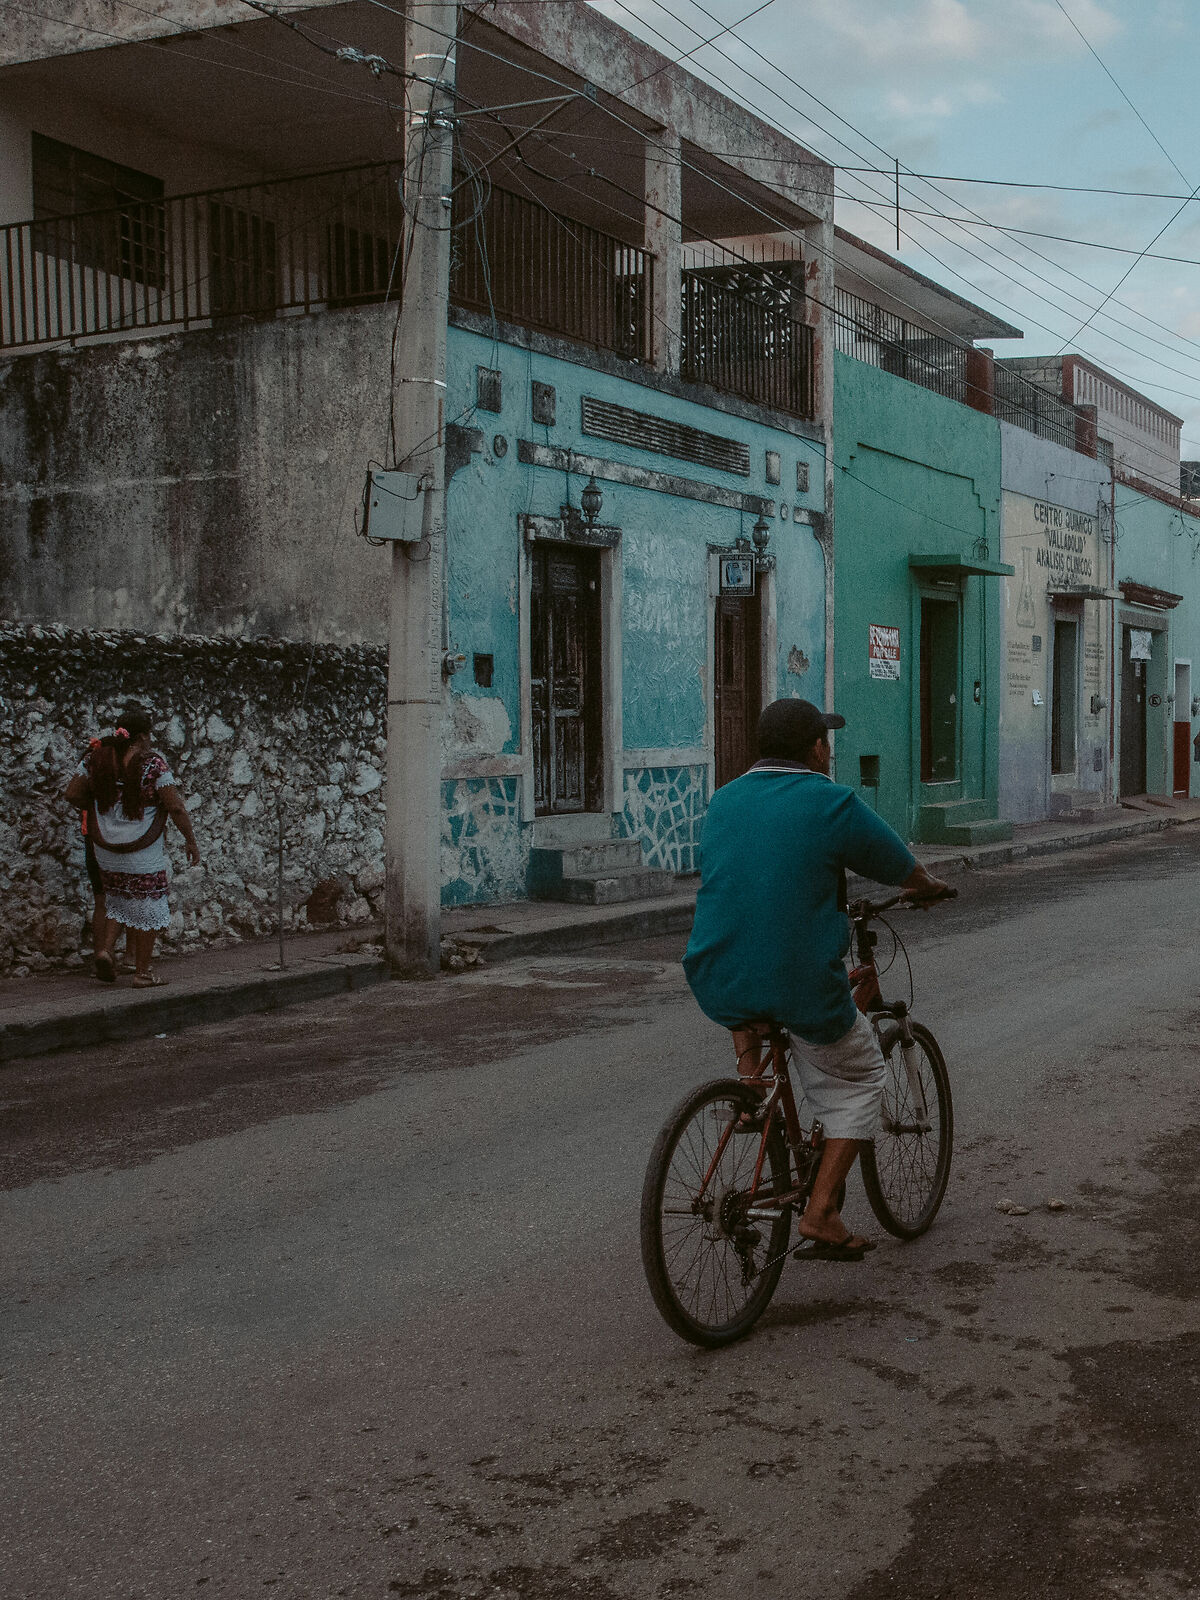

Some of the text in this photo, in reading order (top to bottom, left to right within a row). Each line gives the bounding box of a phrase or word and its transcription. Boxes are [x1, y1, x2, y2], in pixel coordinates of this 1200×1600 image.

[1034, 502, 1093, 535] CENTRO QUIMICO
[1037, 547, 1093, 577] ANALISIS CLINICOS
